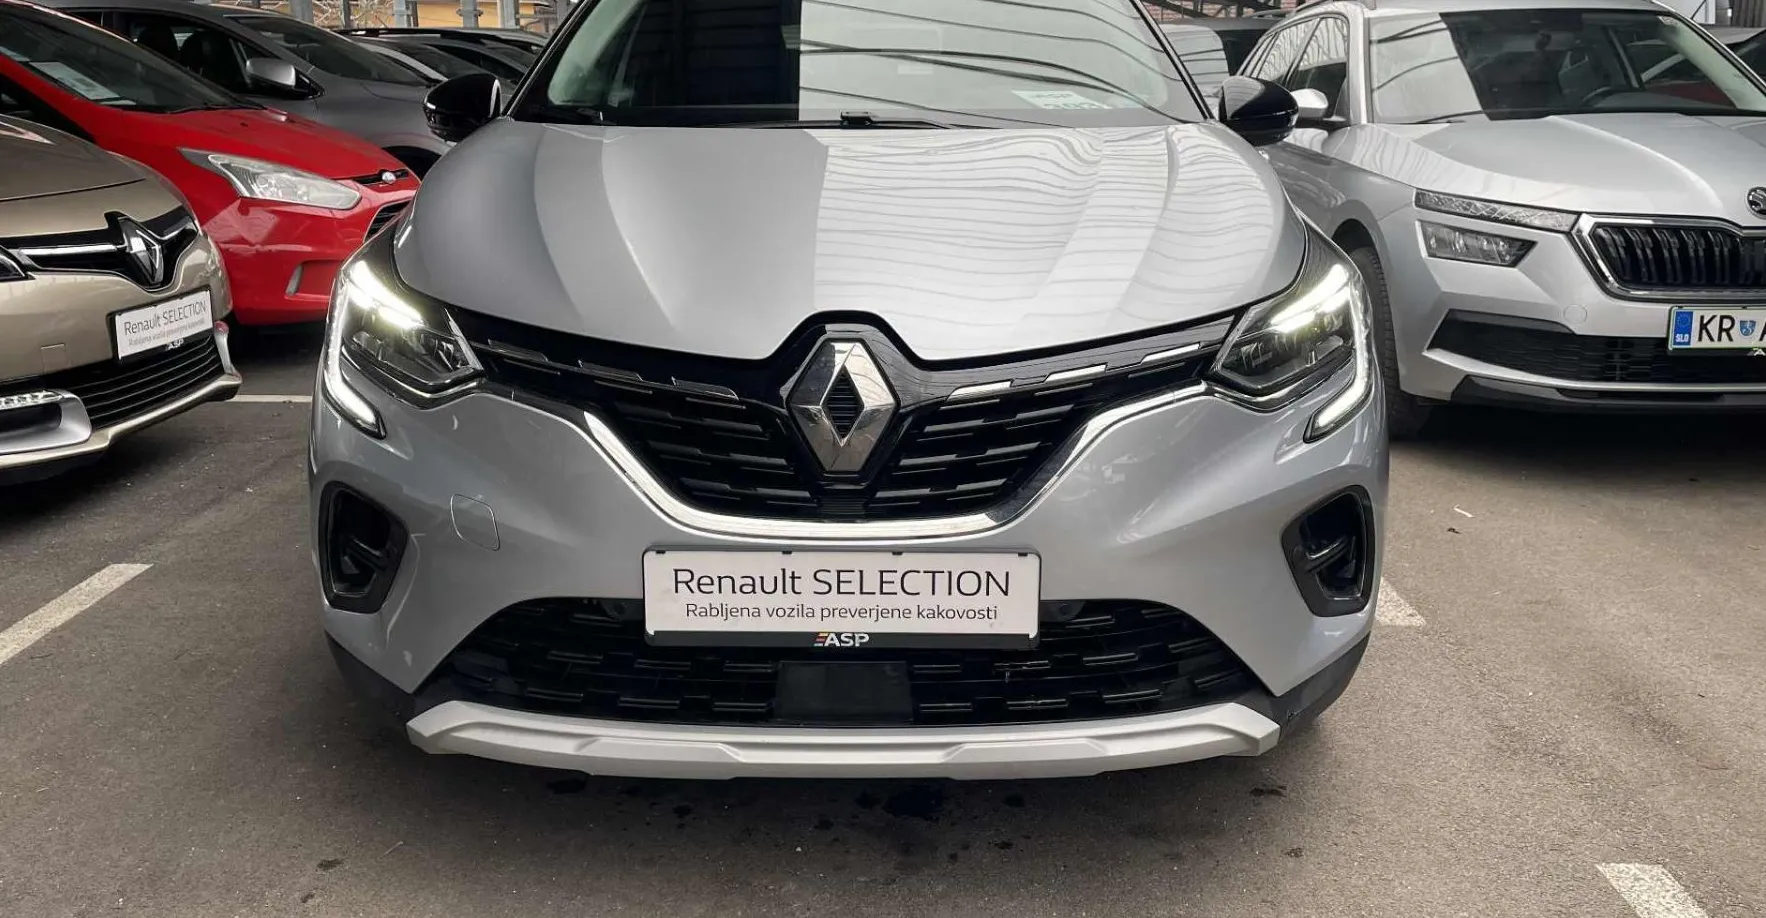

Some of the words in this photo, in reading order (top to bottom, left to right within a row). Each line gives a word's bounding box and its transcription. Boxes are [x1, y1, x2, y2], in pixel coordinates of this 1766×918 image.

[124, 314, 160, 336] Renault
[162, 301, 206, 325] SELECTION
[1698, 315, 1736, 342] KR
[1675, 334, 1689, 342] SLO
[673, 568, 802, 595] Renault
[813, 568, 1010, 597] SELECTION
[686, 602, 761, 621] Rabljena
[766, 603, 815, 618] vozila
[820, 604, 912, 623] preverjene
[917, 604, 998, 620] kakovosti
[823, 632, 870, 647] ASP
